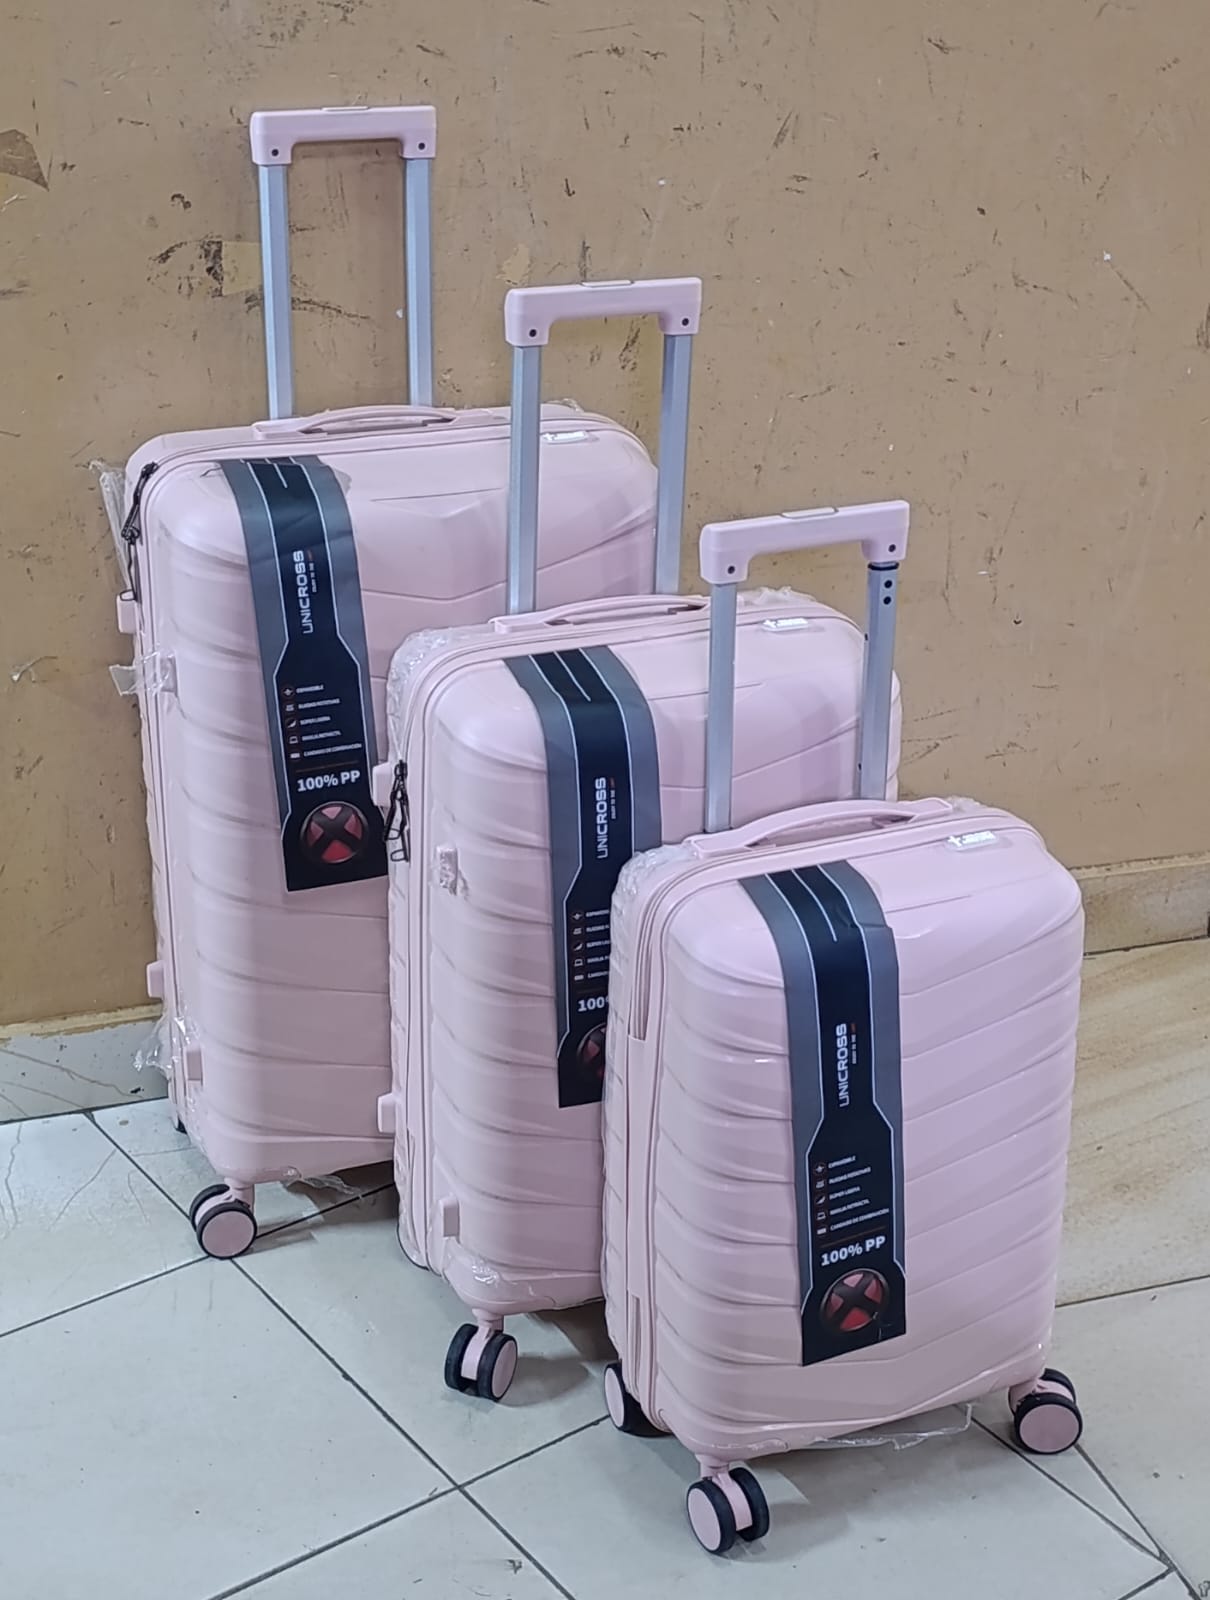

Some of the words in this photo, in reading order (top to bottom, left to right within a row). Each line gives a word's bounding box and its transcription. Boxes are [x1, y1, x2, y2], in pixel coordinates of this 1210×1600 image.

[293, 550, 314, 634] UNICROSS
[297, 774, 339, 792] 100%
[341, 770, 361, 785] PP
[595, 777, 609, 859] UNICROSS
[578, 996, 609, 1012] 100
[836, 1023, 850, 1107] UNICROSS
[821, 1242, 863, 1266] 100%
[865, 1236, 886, 1252] PP
